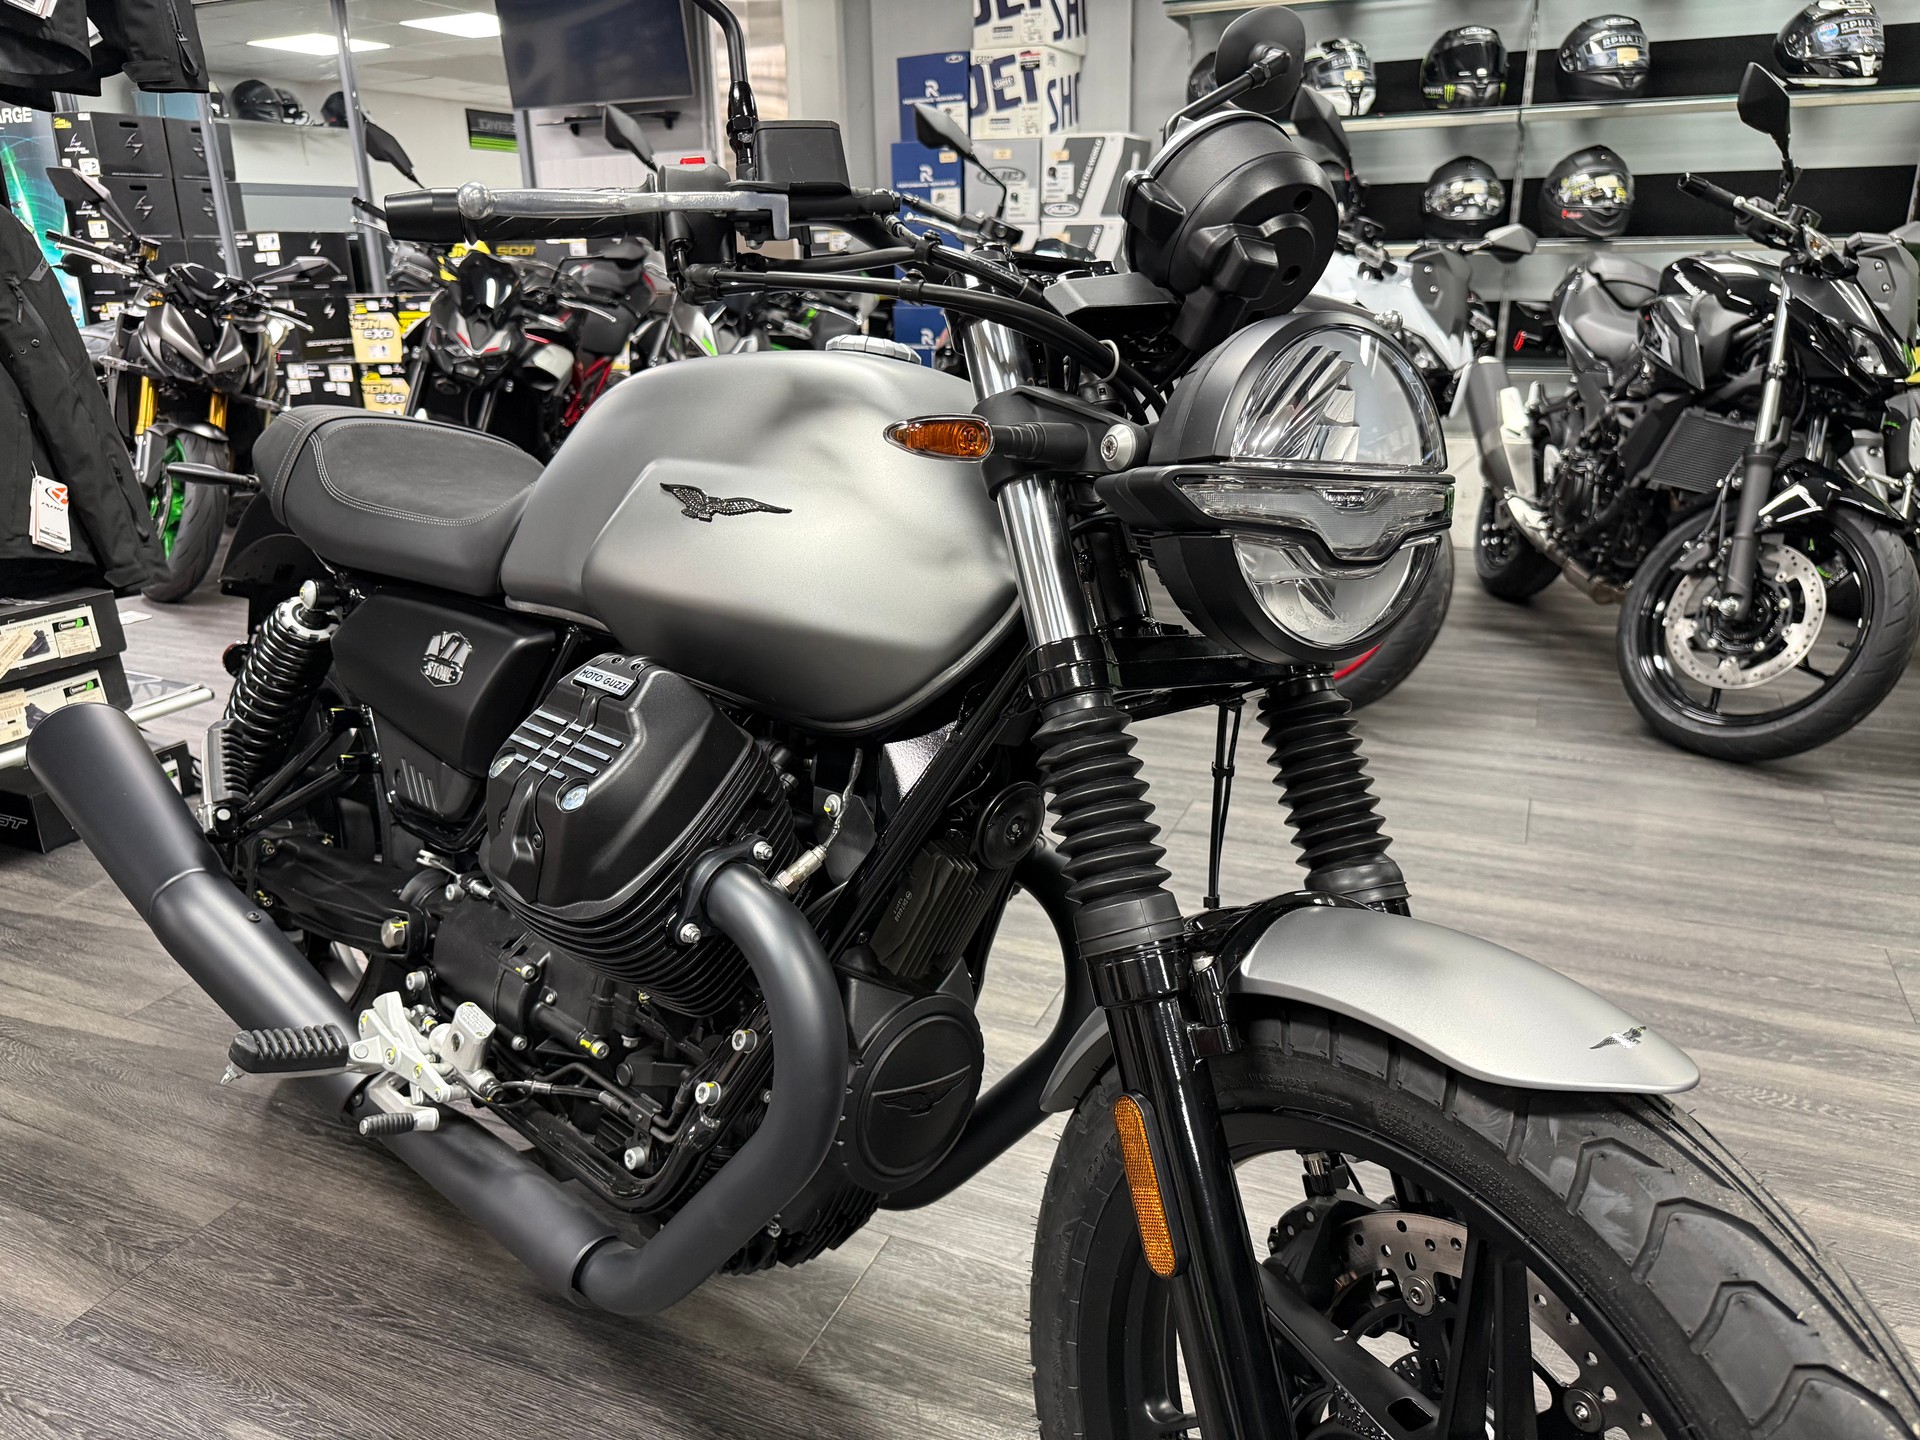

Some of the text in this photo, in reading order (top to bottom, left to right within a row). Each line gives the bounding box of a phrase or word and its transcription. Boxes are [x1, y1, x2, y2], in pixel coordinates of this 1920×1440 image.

[425, 661, 454, 683] STONE
[579, 669, 630, 692] MOTO GUZZI
